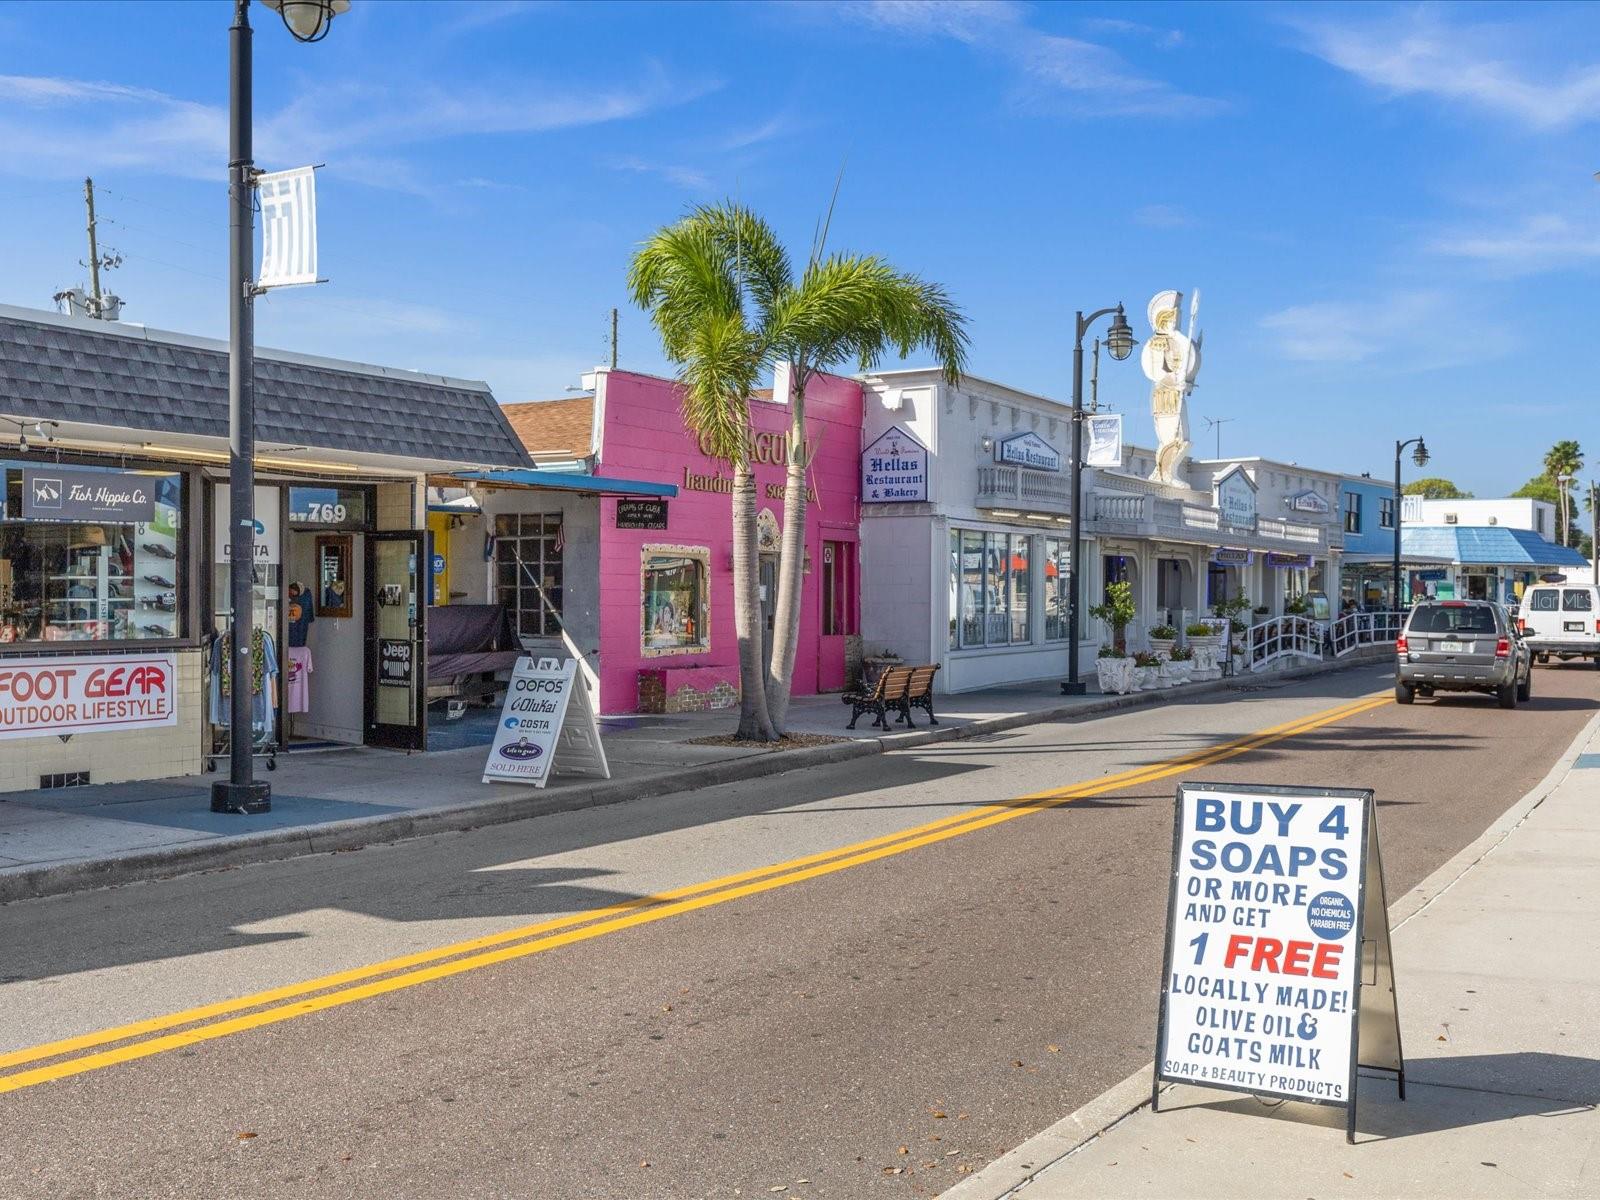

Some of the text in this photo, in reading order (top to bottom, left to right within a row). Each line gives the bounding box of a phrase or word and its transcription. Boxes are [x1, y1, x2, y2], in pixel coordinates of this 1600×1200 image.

[870, 458, 918, 472] Hellas
[865, 474, 922, 485] Restaurant
[68, 484, 147, 507] Fish Hippie Co.
[872, 488, 918, 498] & Bakery
[308, 503, 347, 521] 769
[383, 642, 410, 660] Jeep
[0, 666, 166, 702] FOOT GEAR
[516, 679, 563, 693] OOFOS
[0, 698, 166, 725] UTDOOR LIFESTYLE
[519, 698, 558, 713] OluKai
[520, 719, 550, 729] COSTA
[490, 762, 542, 774] SOLD HERE
[1195, 798, 1349, 840] BUY 4
[1189, 839, 1348, 881] SOAPS
[1187, 876, 1308, 907] OR MORE
[1319, 896, 1345, 907] ORGANIC
[1184, 903, 1271, 928] AND GET
[1311, 907, 1351, 919] NO CHEMICALS
[1310, 919, 1351, 931] PARABEN FREE
[1189, 932, 1345, 980] 1 FREE
[1171, 973, 1349, 1014] LOCALLY MADE!
[1195, 1006, 1318, 1041] OLIVE OIL &
[1187, 1032, 1322, 1070] GOATS MILK
[1164, 1060, 1343, 1099] SOAP & BEAUTY PRODUCTS
